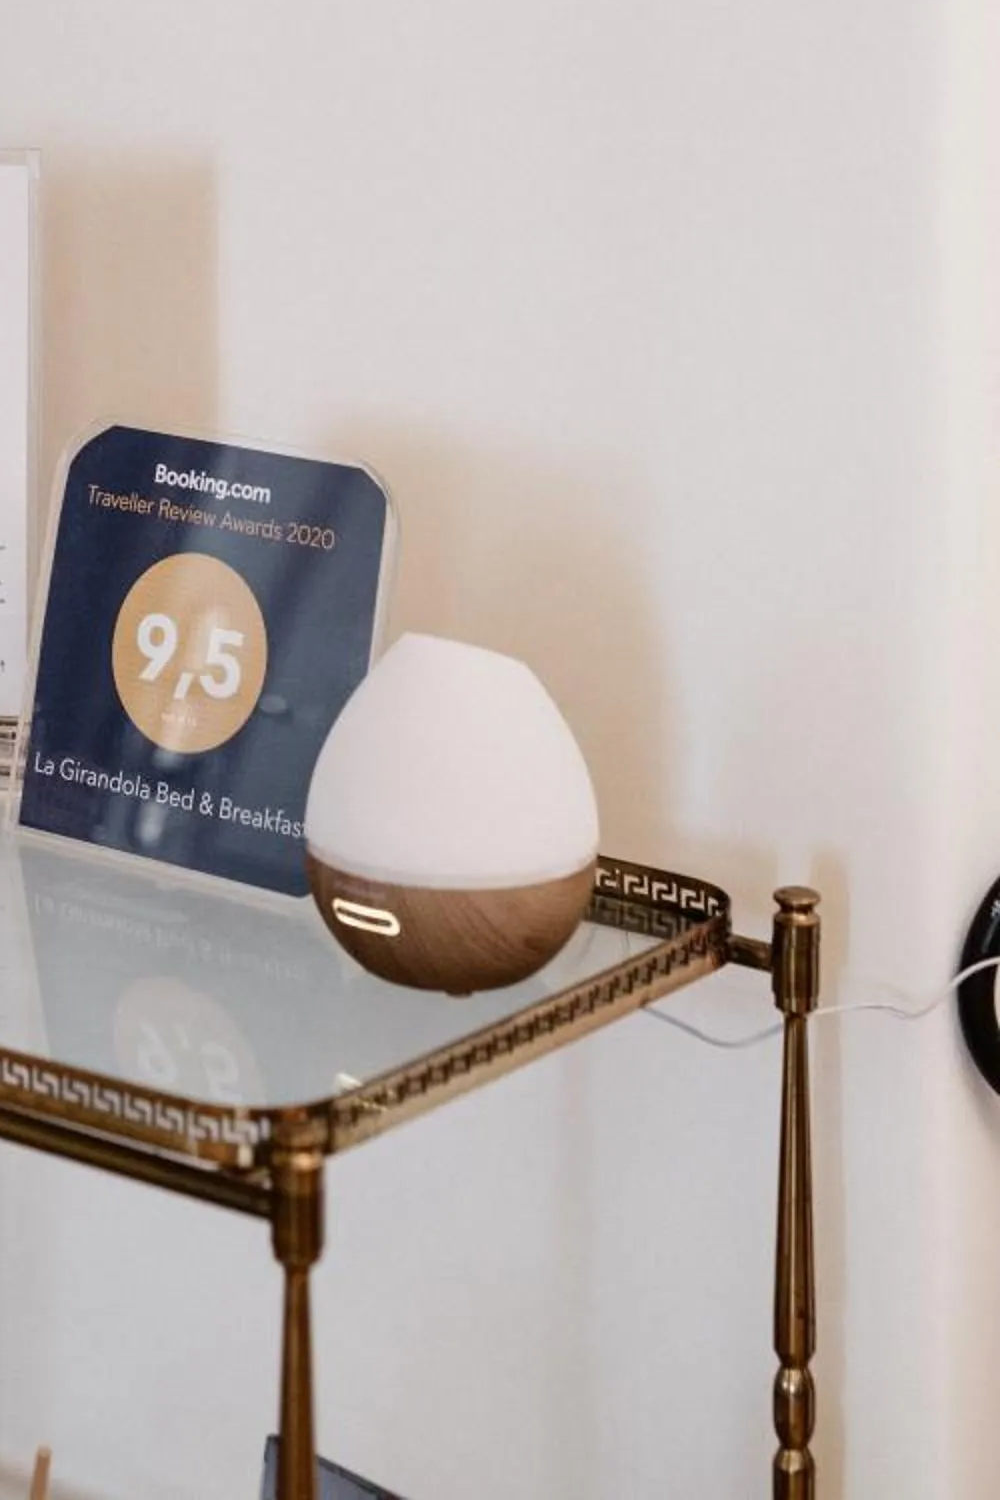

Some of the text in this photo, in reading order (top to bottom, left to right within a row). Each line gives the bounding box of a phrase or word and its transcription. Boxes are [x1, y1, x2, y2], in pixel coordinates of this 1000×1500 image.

[88, 483, 335, 550] Traveller Review Awards 2020
[155, 463, 271, 504] Booking.com
[136, 611, 244, 700] 9,5
[34, 751, 55, 776] La
[60, 757, 151, 800] Girandola
[156, 781, 195, 811] Bed
[199, 791, 214, 817] &
